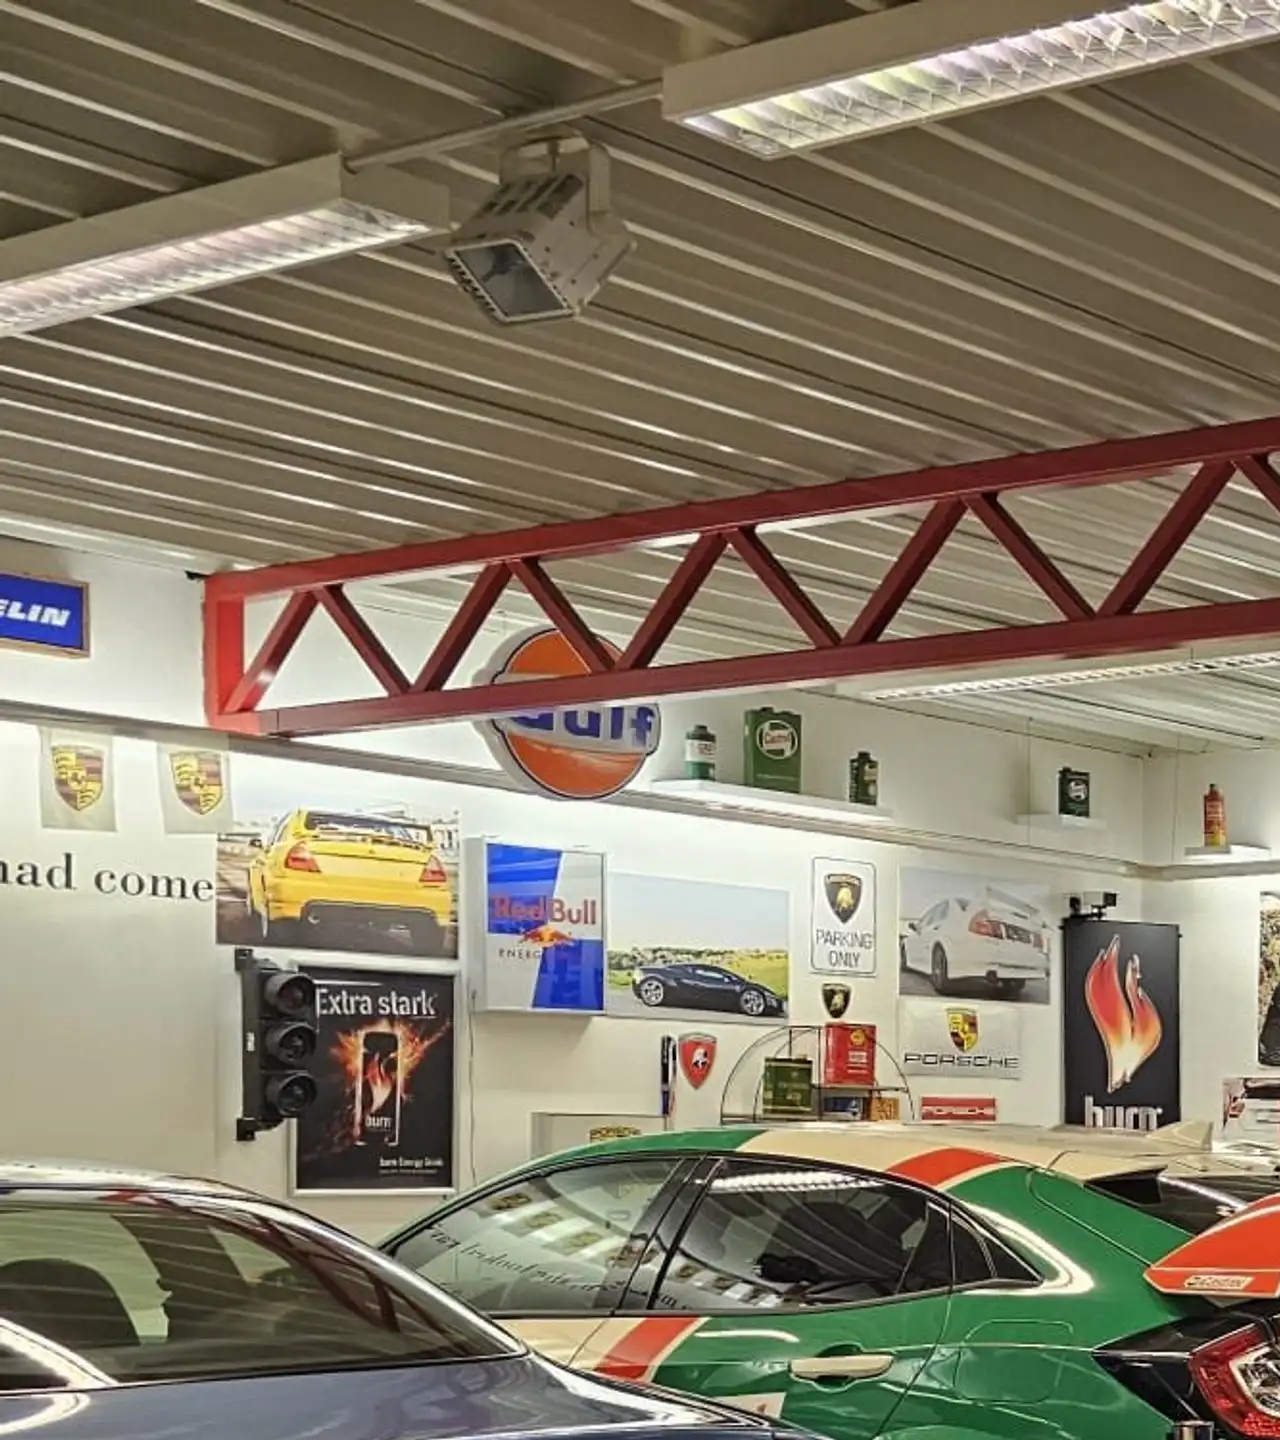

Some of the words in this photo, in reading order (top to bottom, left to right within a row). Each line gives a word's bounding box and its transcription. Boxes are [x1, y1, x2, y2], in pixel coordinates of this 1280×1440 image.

[94, 868, 214, 902] come
[548, 898, 596, 925] Bull
[816, 928, 873, 950] PARKING
[828, 950, 861, 969] ONLY
[315, 987, 372, 1017] Extra
[378, 988, 436, 1016] stark
[904, 1053, 1020, 1069] PORSCHE
